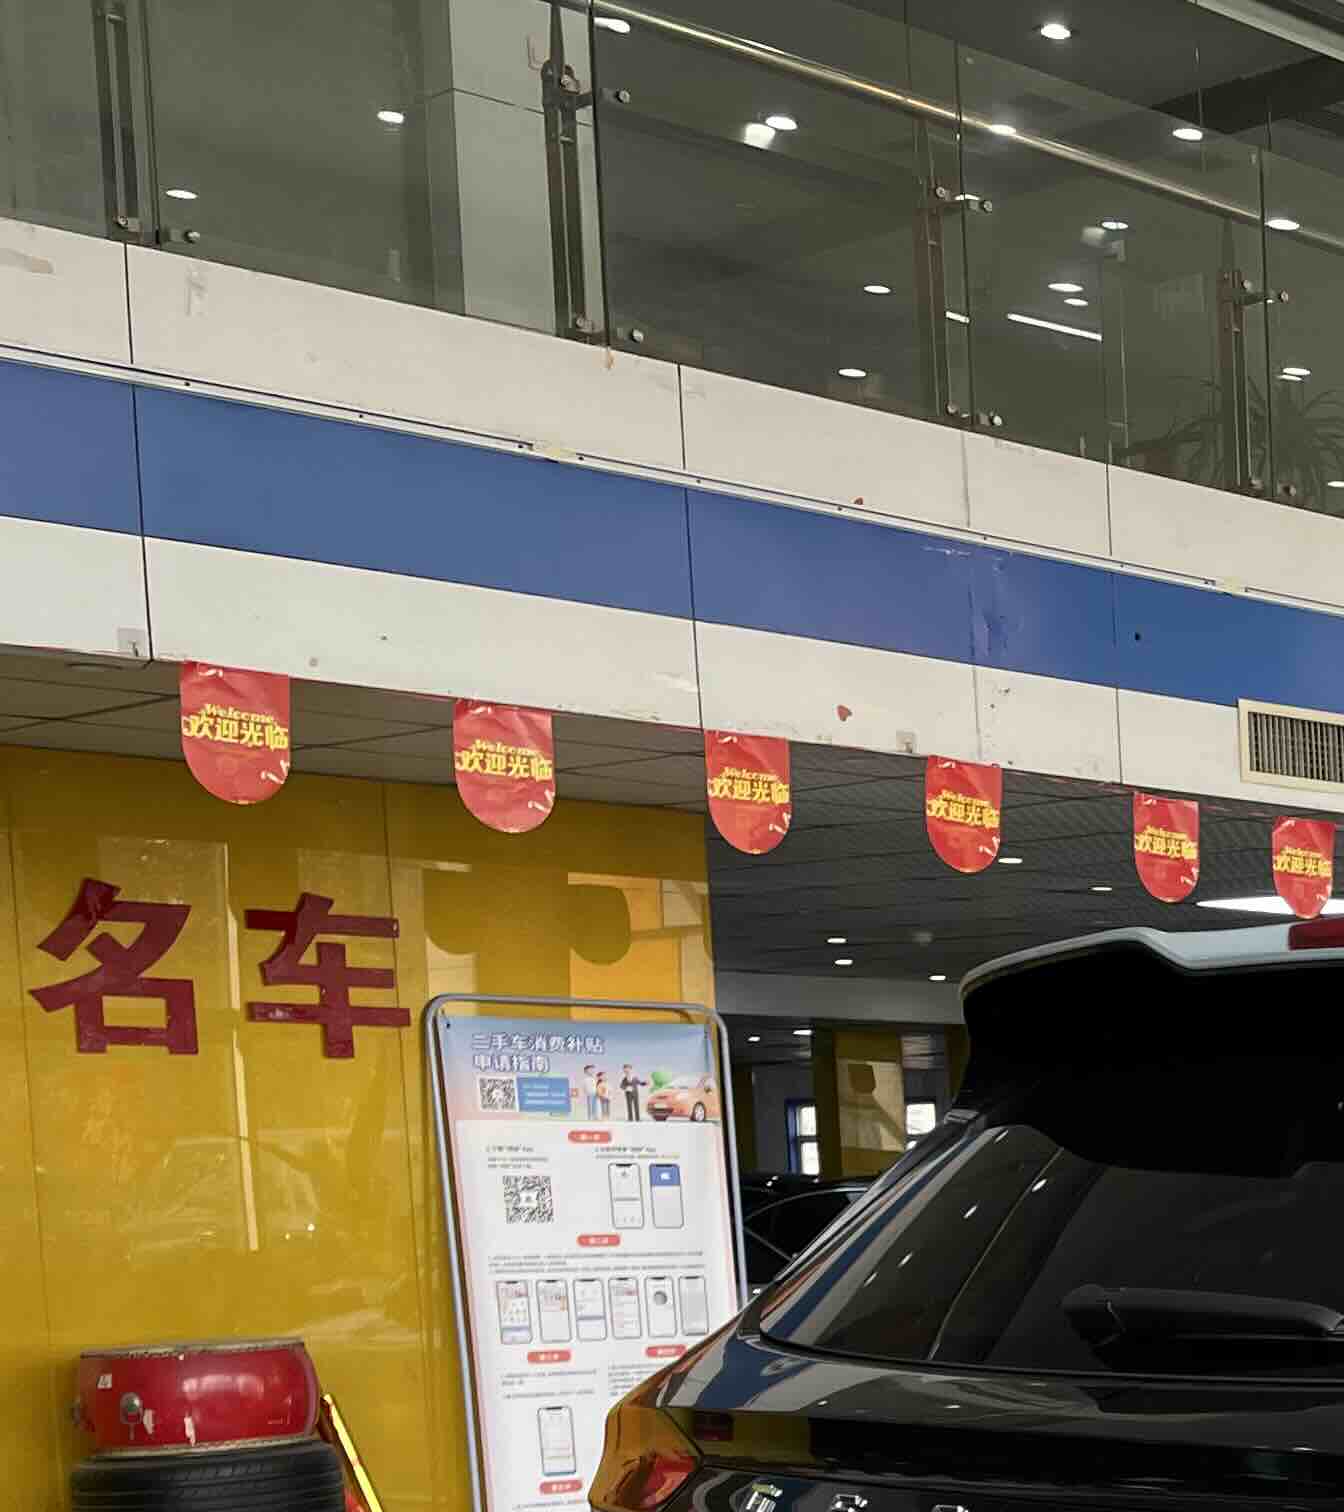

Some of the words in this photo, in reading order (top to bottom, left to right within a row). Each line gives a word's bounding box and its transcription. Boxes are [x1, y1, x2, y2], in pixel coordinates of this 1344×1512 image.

[181, 711, 289, 752] 欢迎光临
[454, 750, 553, 782] 欢迎光临
[707, 777, 790, 805] 欢迎光临
[926, 799, 1000, 829] 欢迎光临
[1135, 833, 1199, 860] 欢迎光临
[1272, 855, 1332, 878] 欢迎光临
[28, 877, 411, 1059] 名车
[471, 1032, 606, 1054] 二手车消费补贴
[473, 1055, 551, 1073] 申请指南
